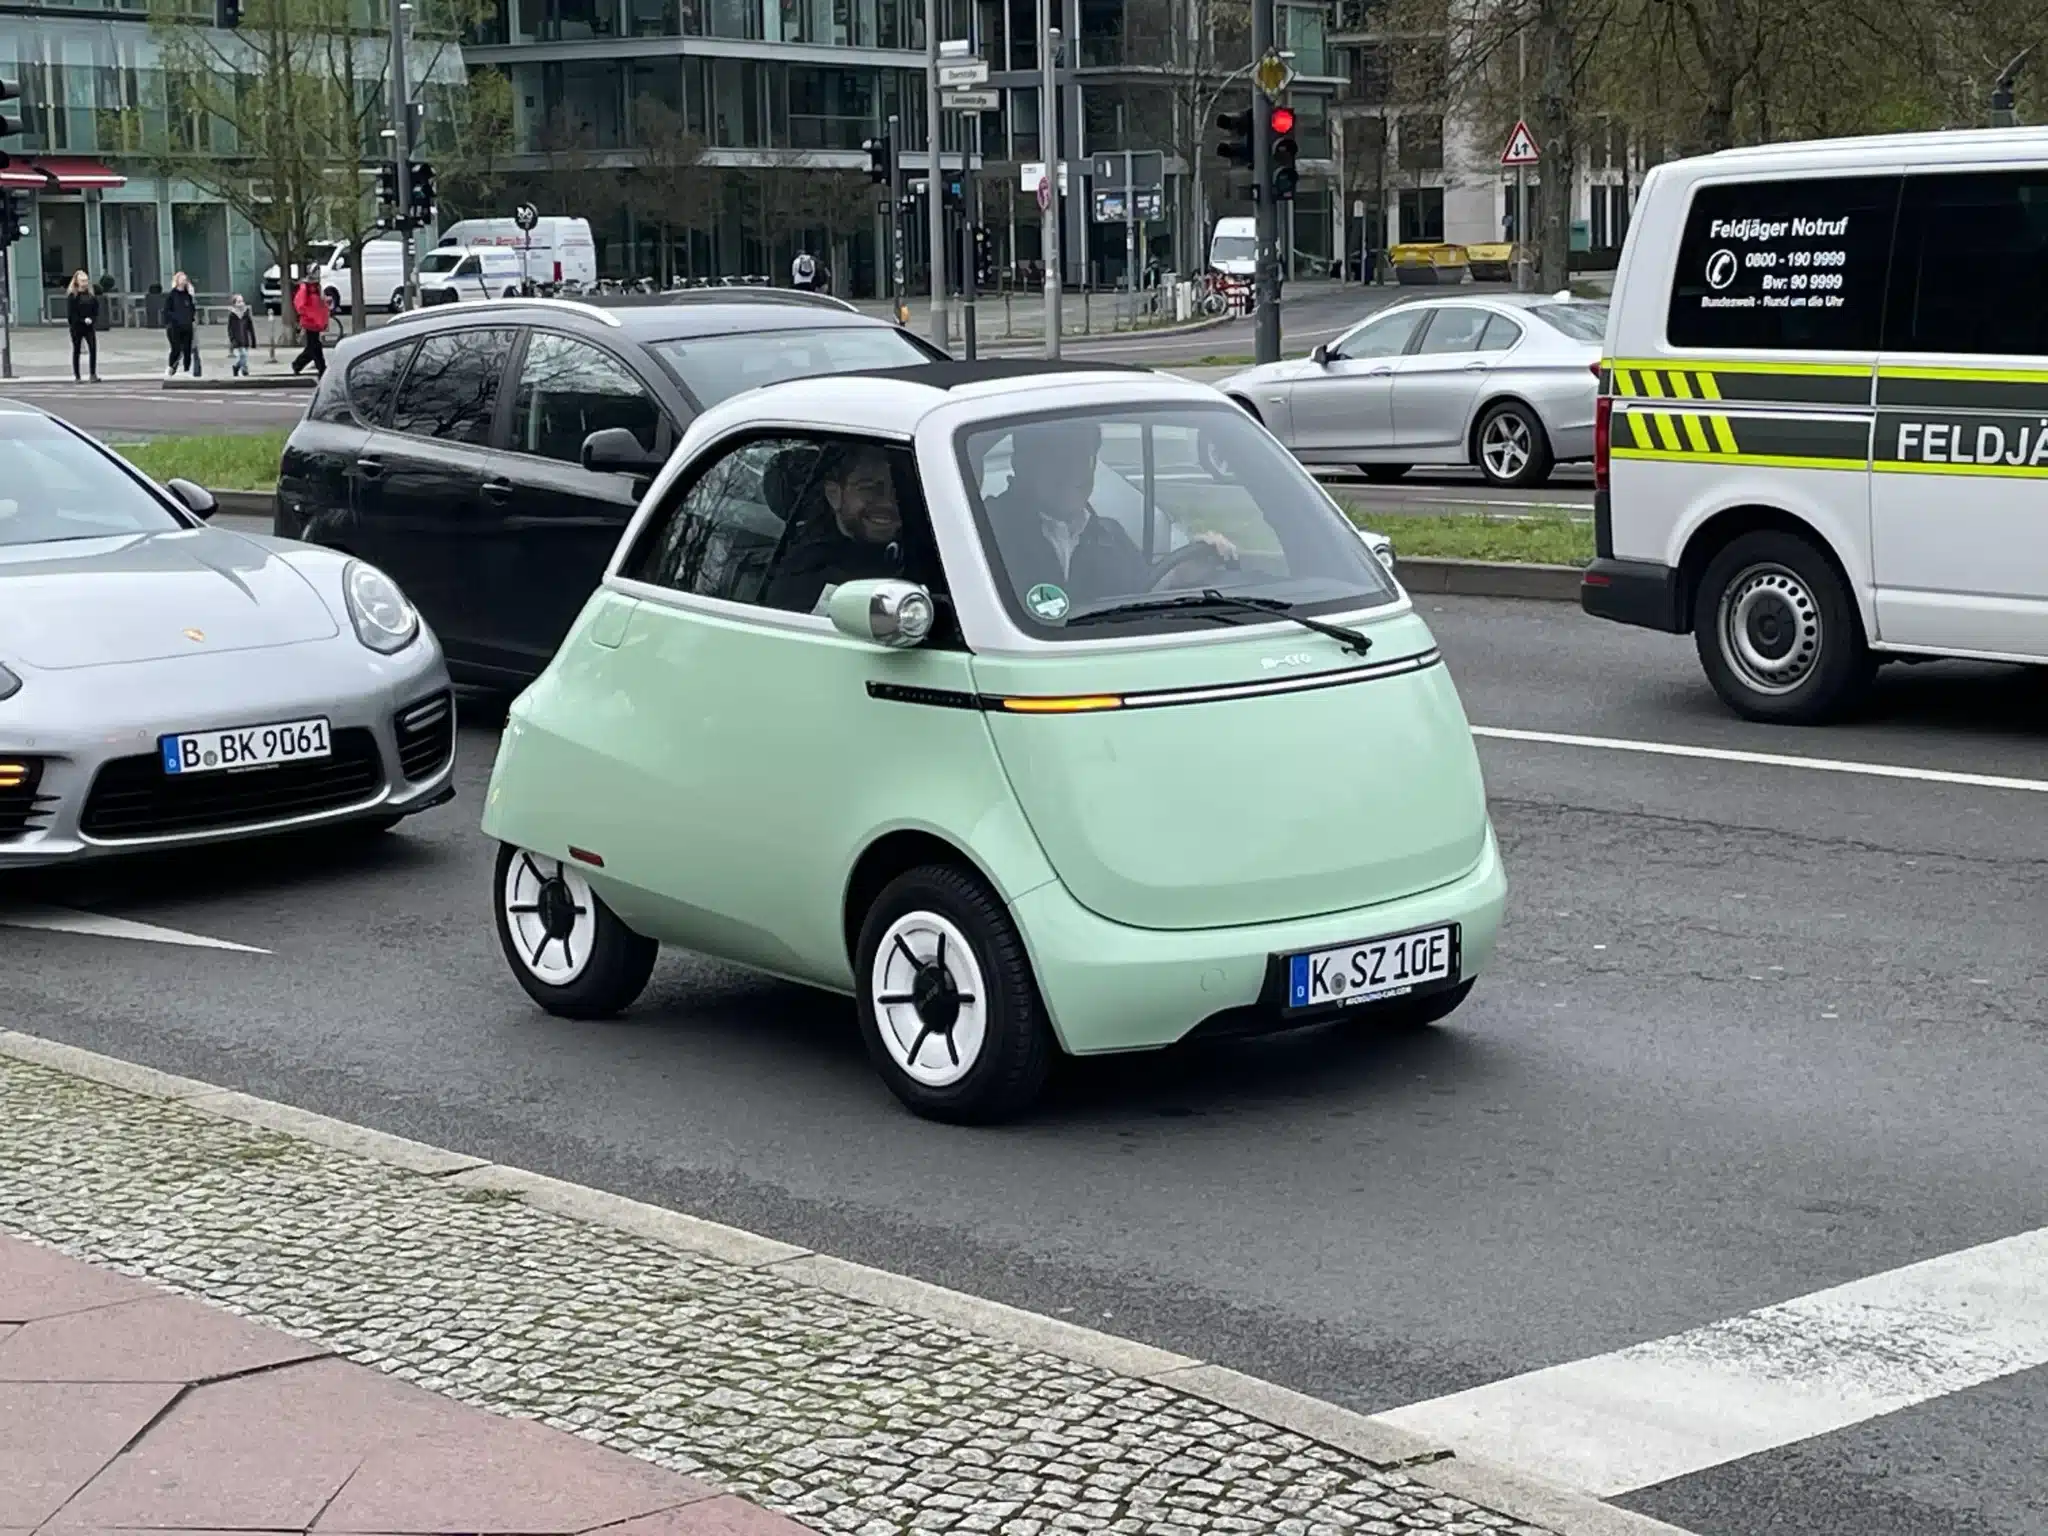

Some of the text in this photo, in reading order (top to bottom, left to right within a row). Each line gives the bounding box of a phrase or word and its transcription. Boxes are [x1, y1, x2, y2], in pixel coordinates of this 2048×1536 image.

[1710, 216, 1849, 241] Feldjäger Notruf
[1745, 252, 1776, 267] 0800
[1787, 251, 1811, 267] 190
[1812, 251, 1846, 266] 9999
[1762, 274, 1843, 290] Bw: 90 9999
[181, 739, 201, 768] B
[219, 731, 258, 764] BK
[262, 723, 328, 758] 9061
[1312, 956, 1331, 998] K
[1350, 946, 1387, 989] SZ
[1393, 934, 1445, 980] 10E
